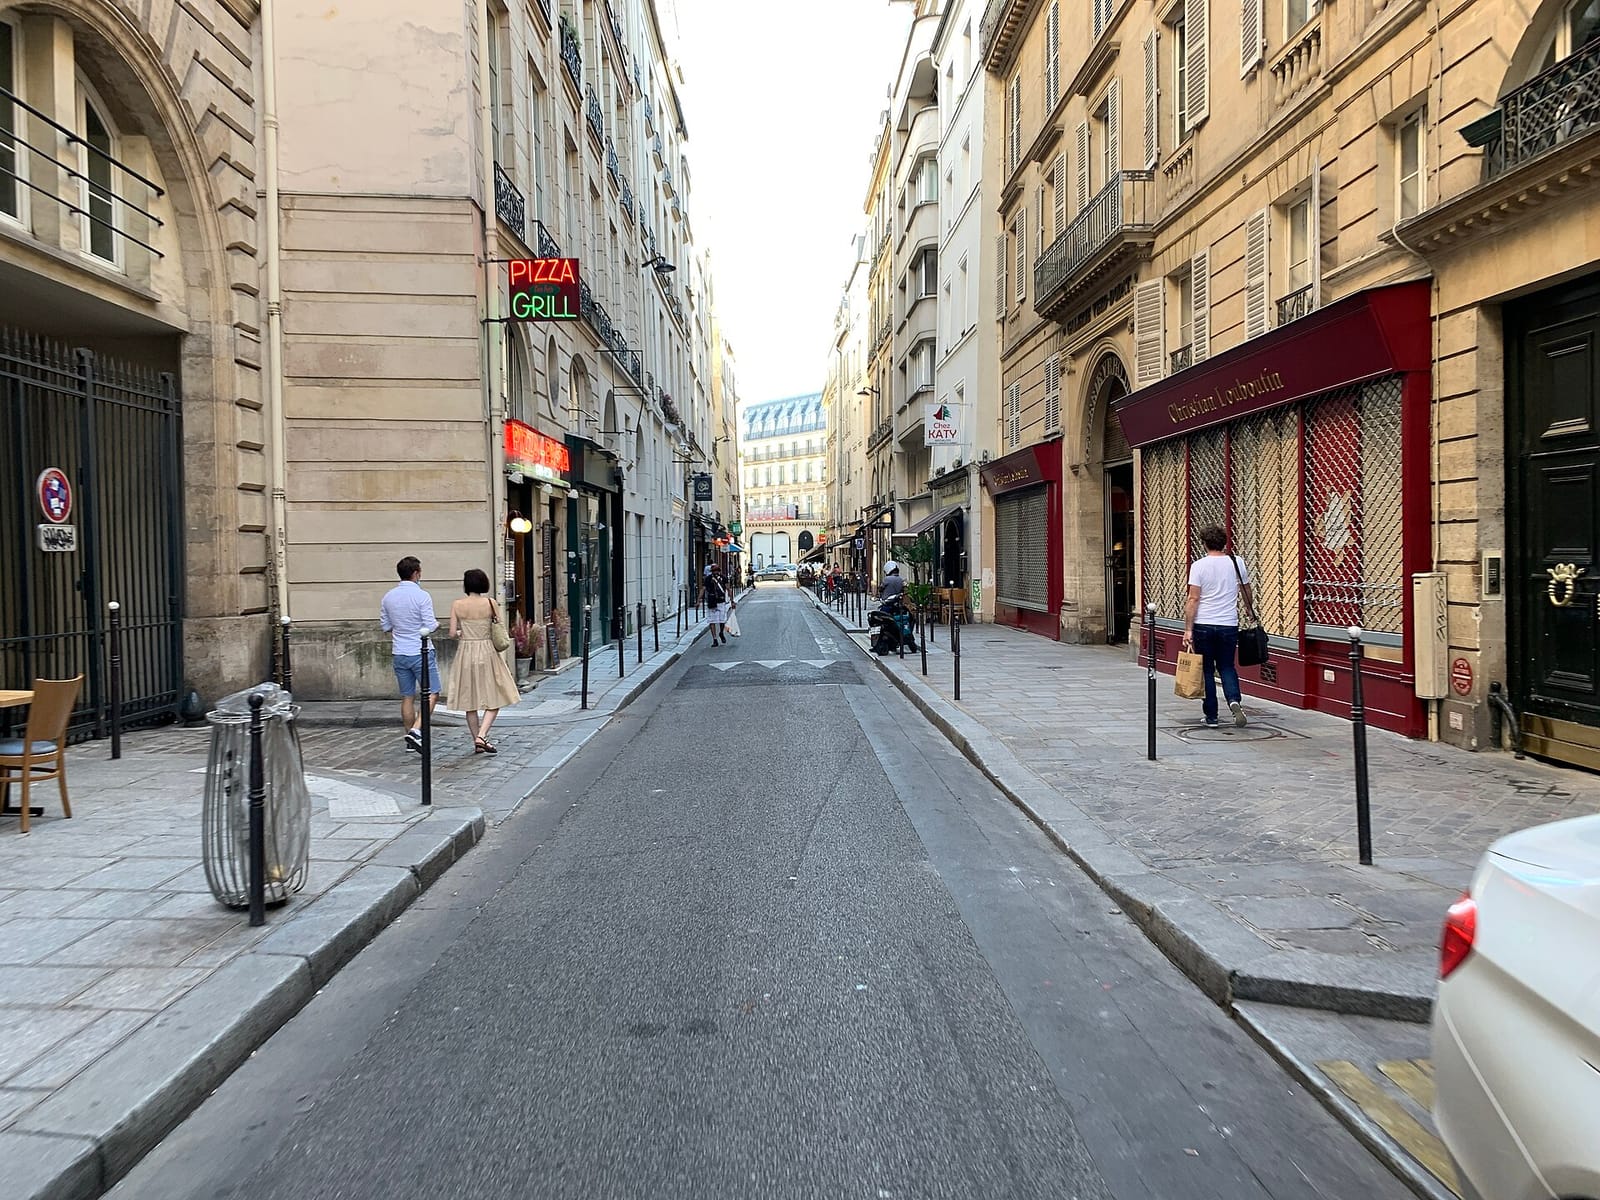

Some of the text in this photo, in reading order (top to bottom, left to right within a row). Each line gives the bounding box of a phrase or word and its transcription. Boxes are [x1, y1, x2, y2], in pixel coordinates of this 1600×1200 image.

[510, 258, 576, 286] PIZZA
[512, 291, 577, 318] GRILL
[1168, 367, 1285, 424] Christian Louboutin
[928, 429, 957, 439] KATY
